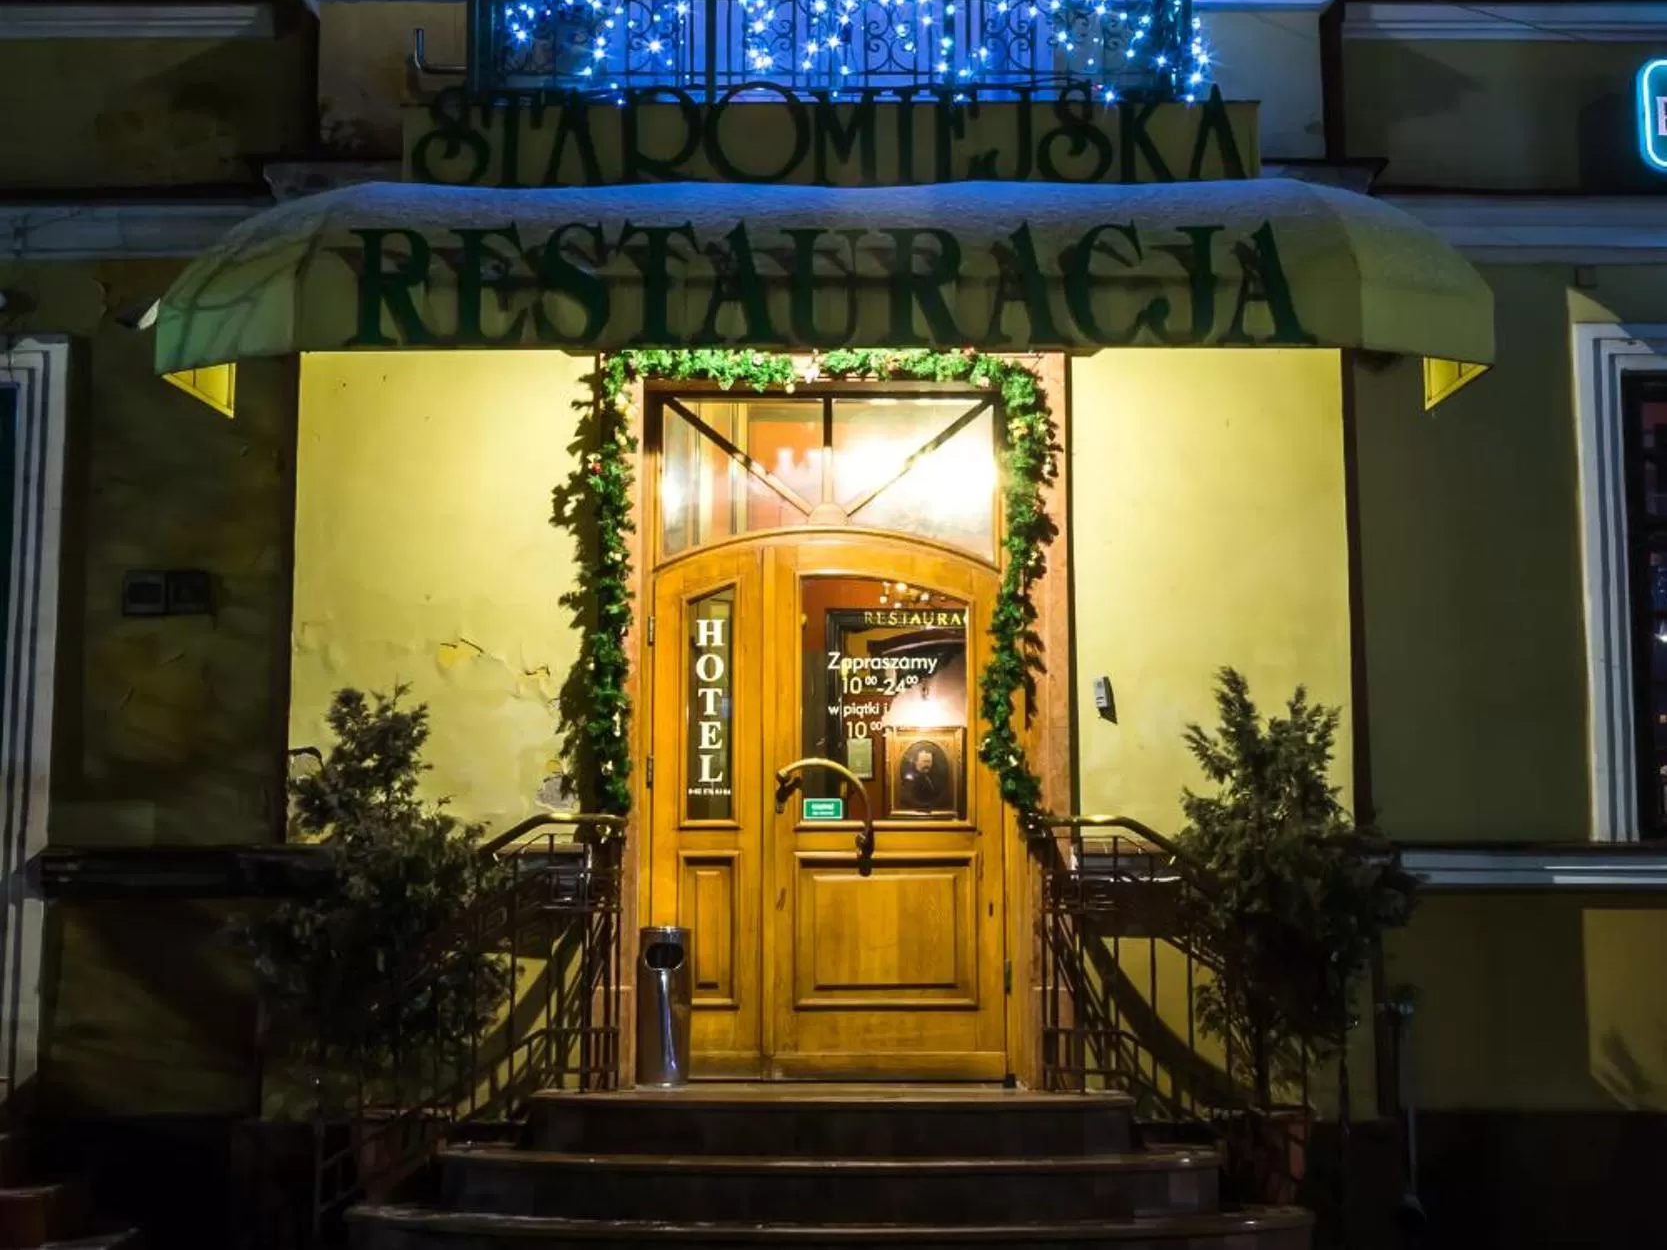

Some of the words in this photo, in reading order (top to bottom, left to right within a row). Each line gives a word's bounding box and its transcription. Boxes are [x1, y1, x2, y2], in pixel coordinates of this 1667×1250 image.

[411, 81, 1248, 188] STAROMIEJSKA
[343, 218, 1319, 346] RESTAURACJA
[827, 651, 938, 674] Zapraszamy
[864, 611, 967, 626] RESTAURA
[695, 618, 726, 783] HOTEL
